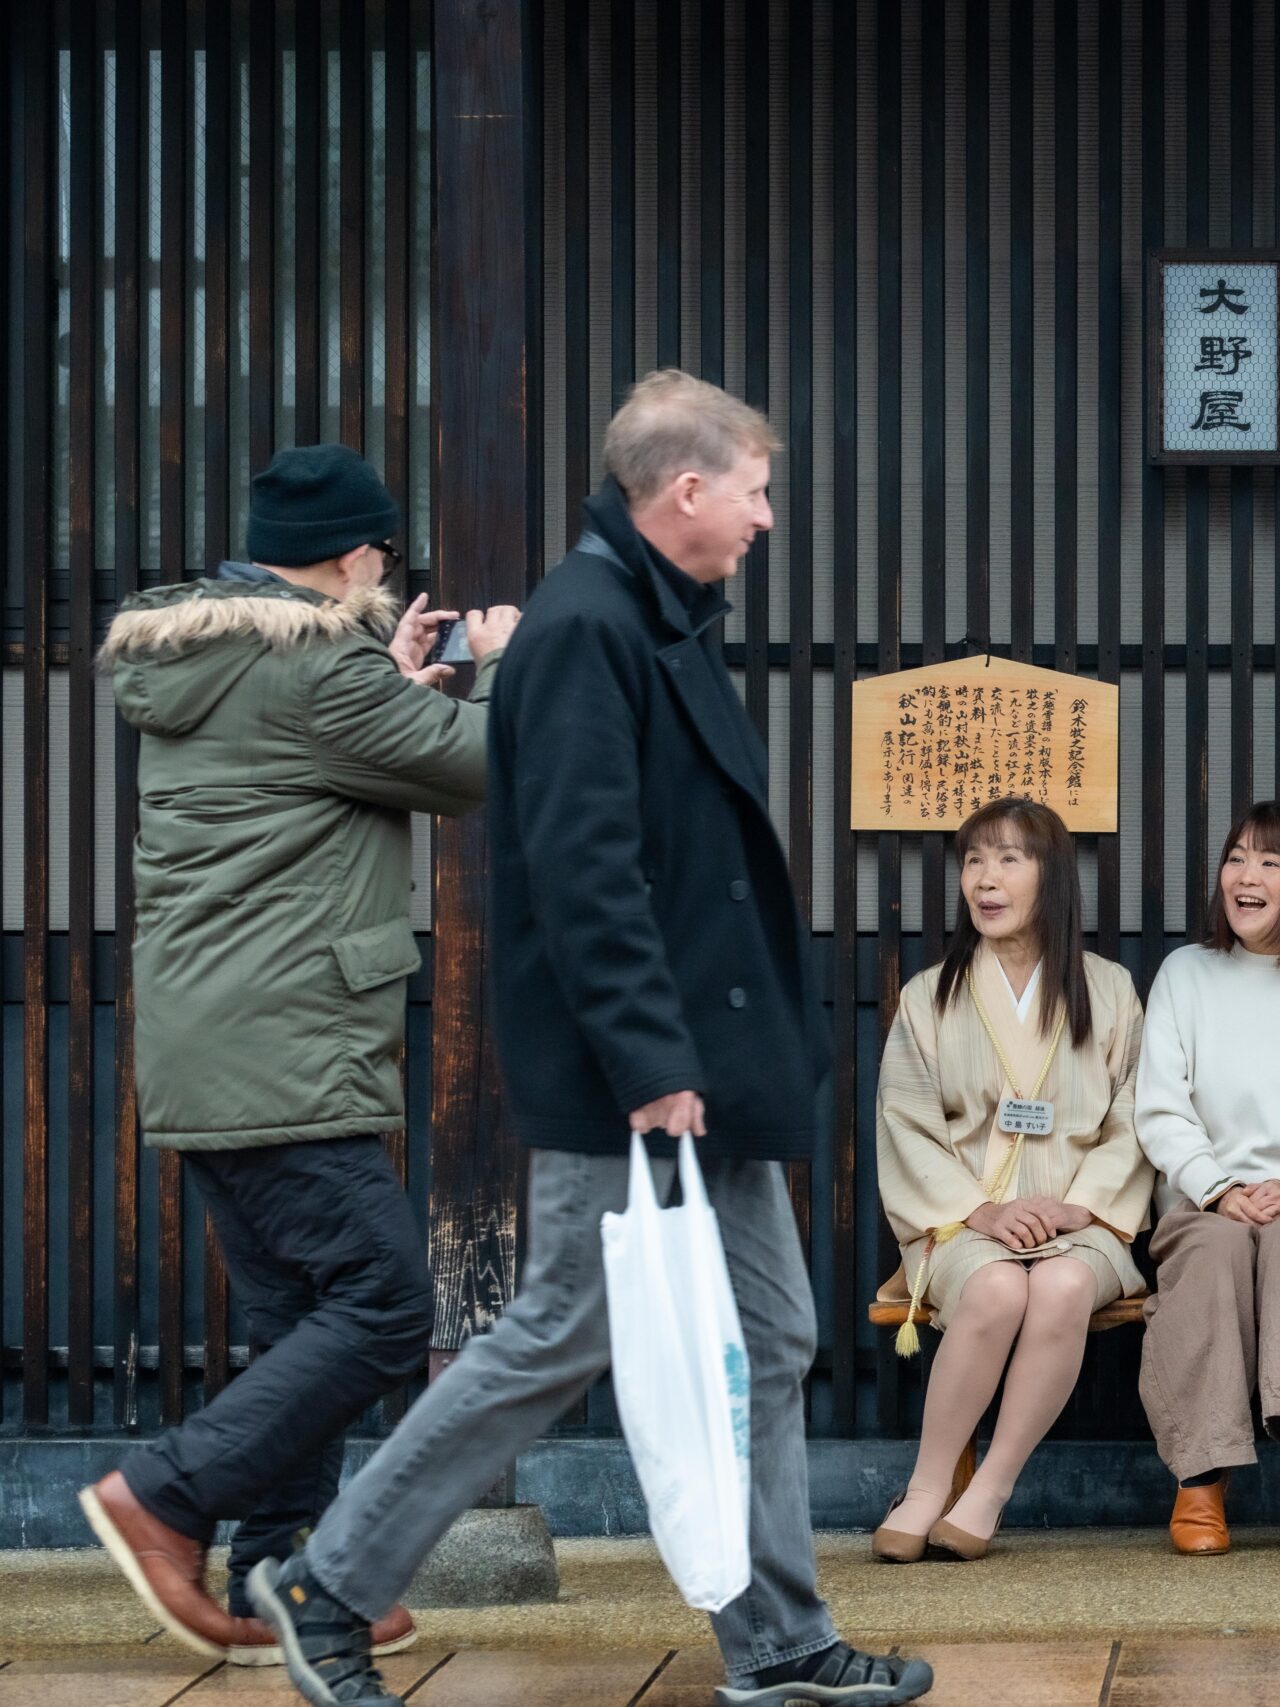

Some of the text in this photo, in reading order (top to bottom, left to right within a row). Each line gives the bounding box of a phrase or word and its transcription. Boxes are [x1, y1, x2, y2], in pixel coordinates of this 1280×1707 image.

[1190, 278, 1253, 432] 大野屋
[1065, 698, 1089, 807] 鈴木牧之記念館には
